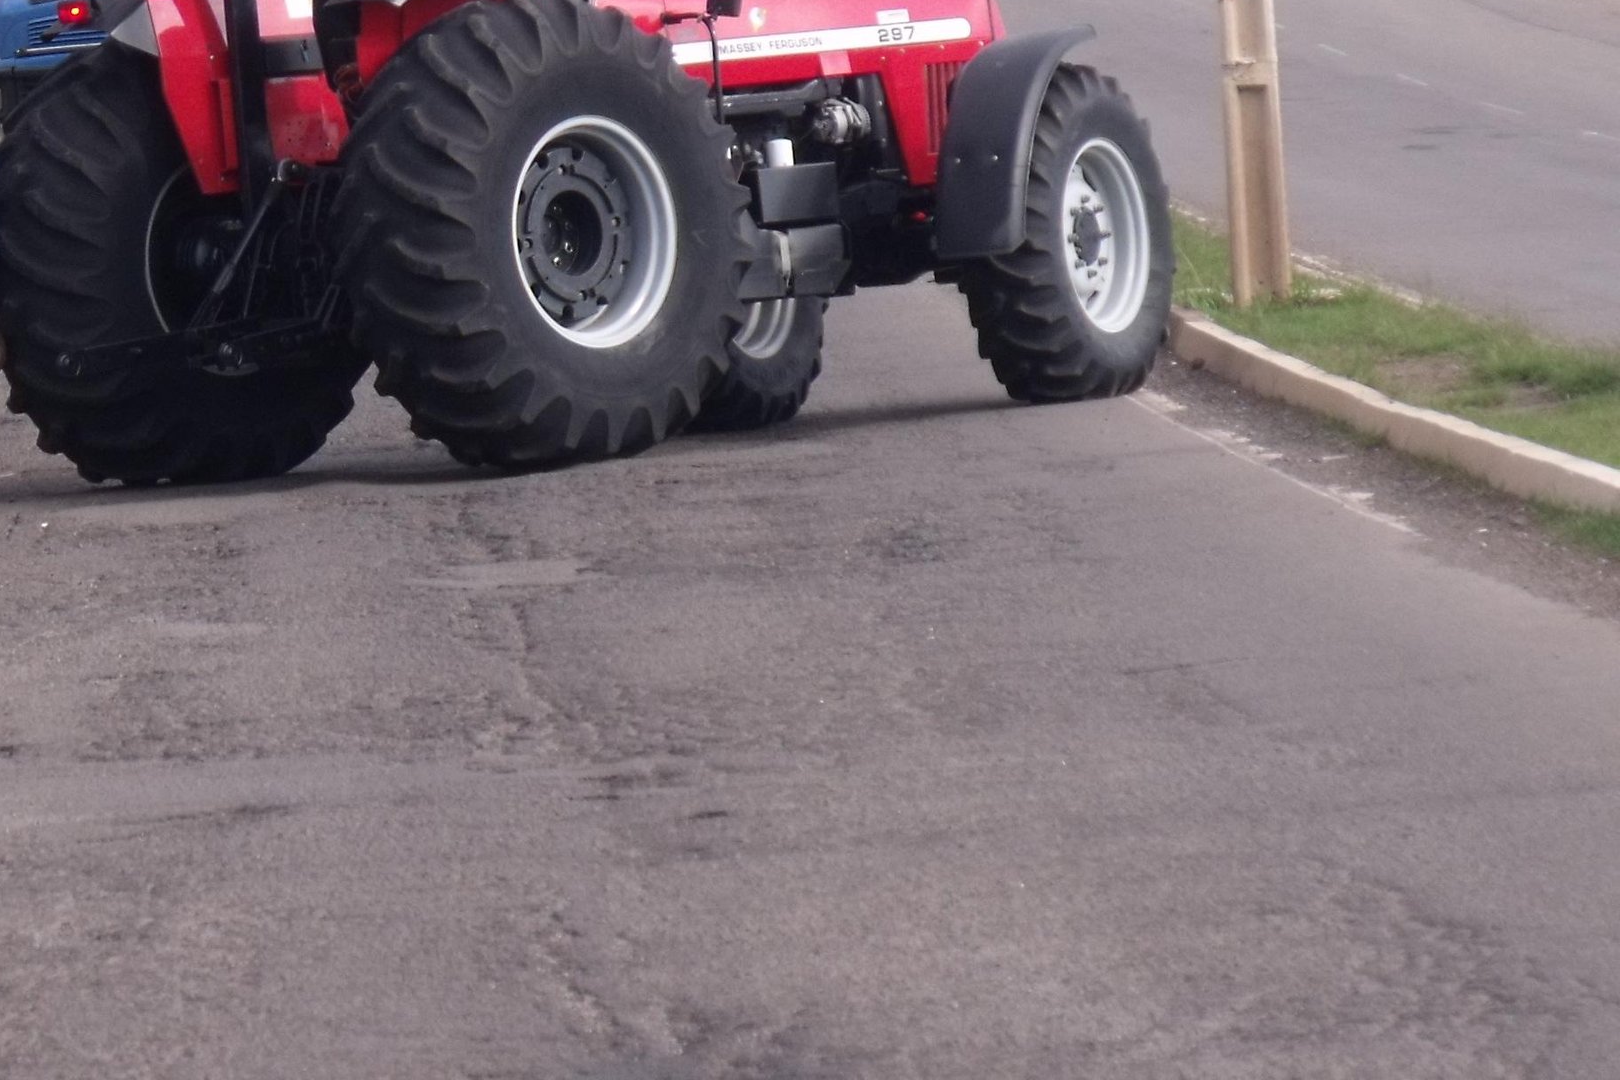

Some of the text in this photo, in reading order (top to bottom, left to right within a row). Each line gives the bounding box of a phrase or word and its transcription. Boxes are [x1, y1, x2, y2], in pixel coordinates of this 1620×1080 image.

[719, 26, 915, 55] MASSEY FERGUSON 297
